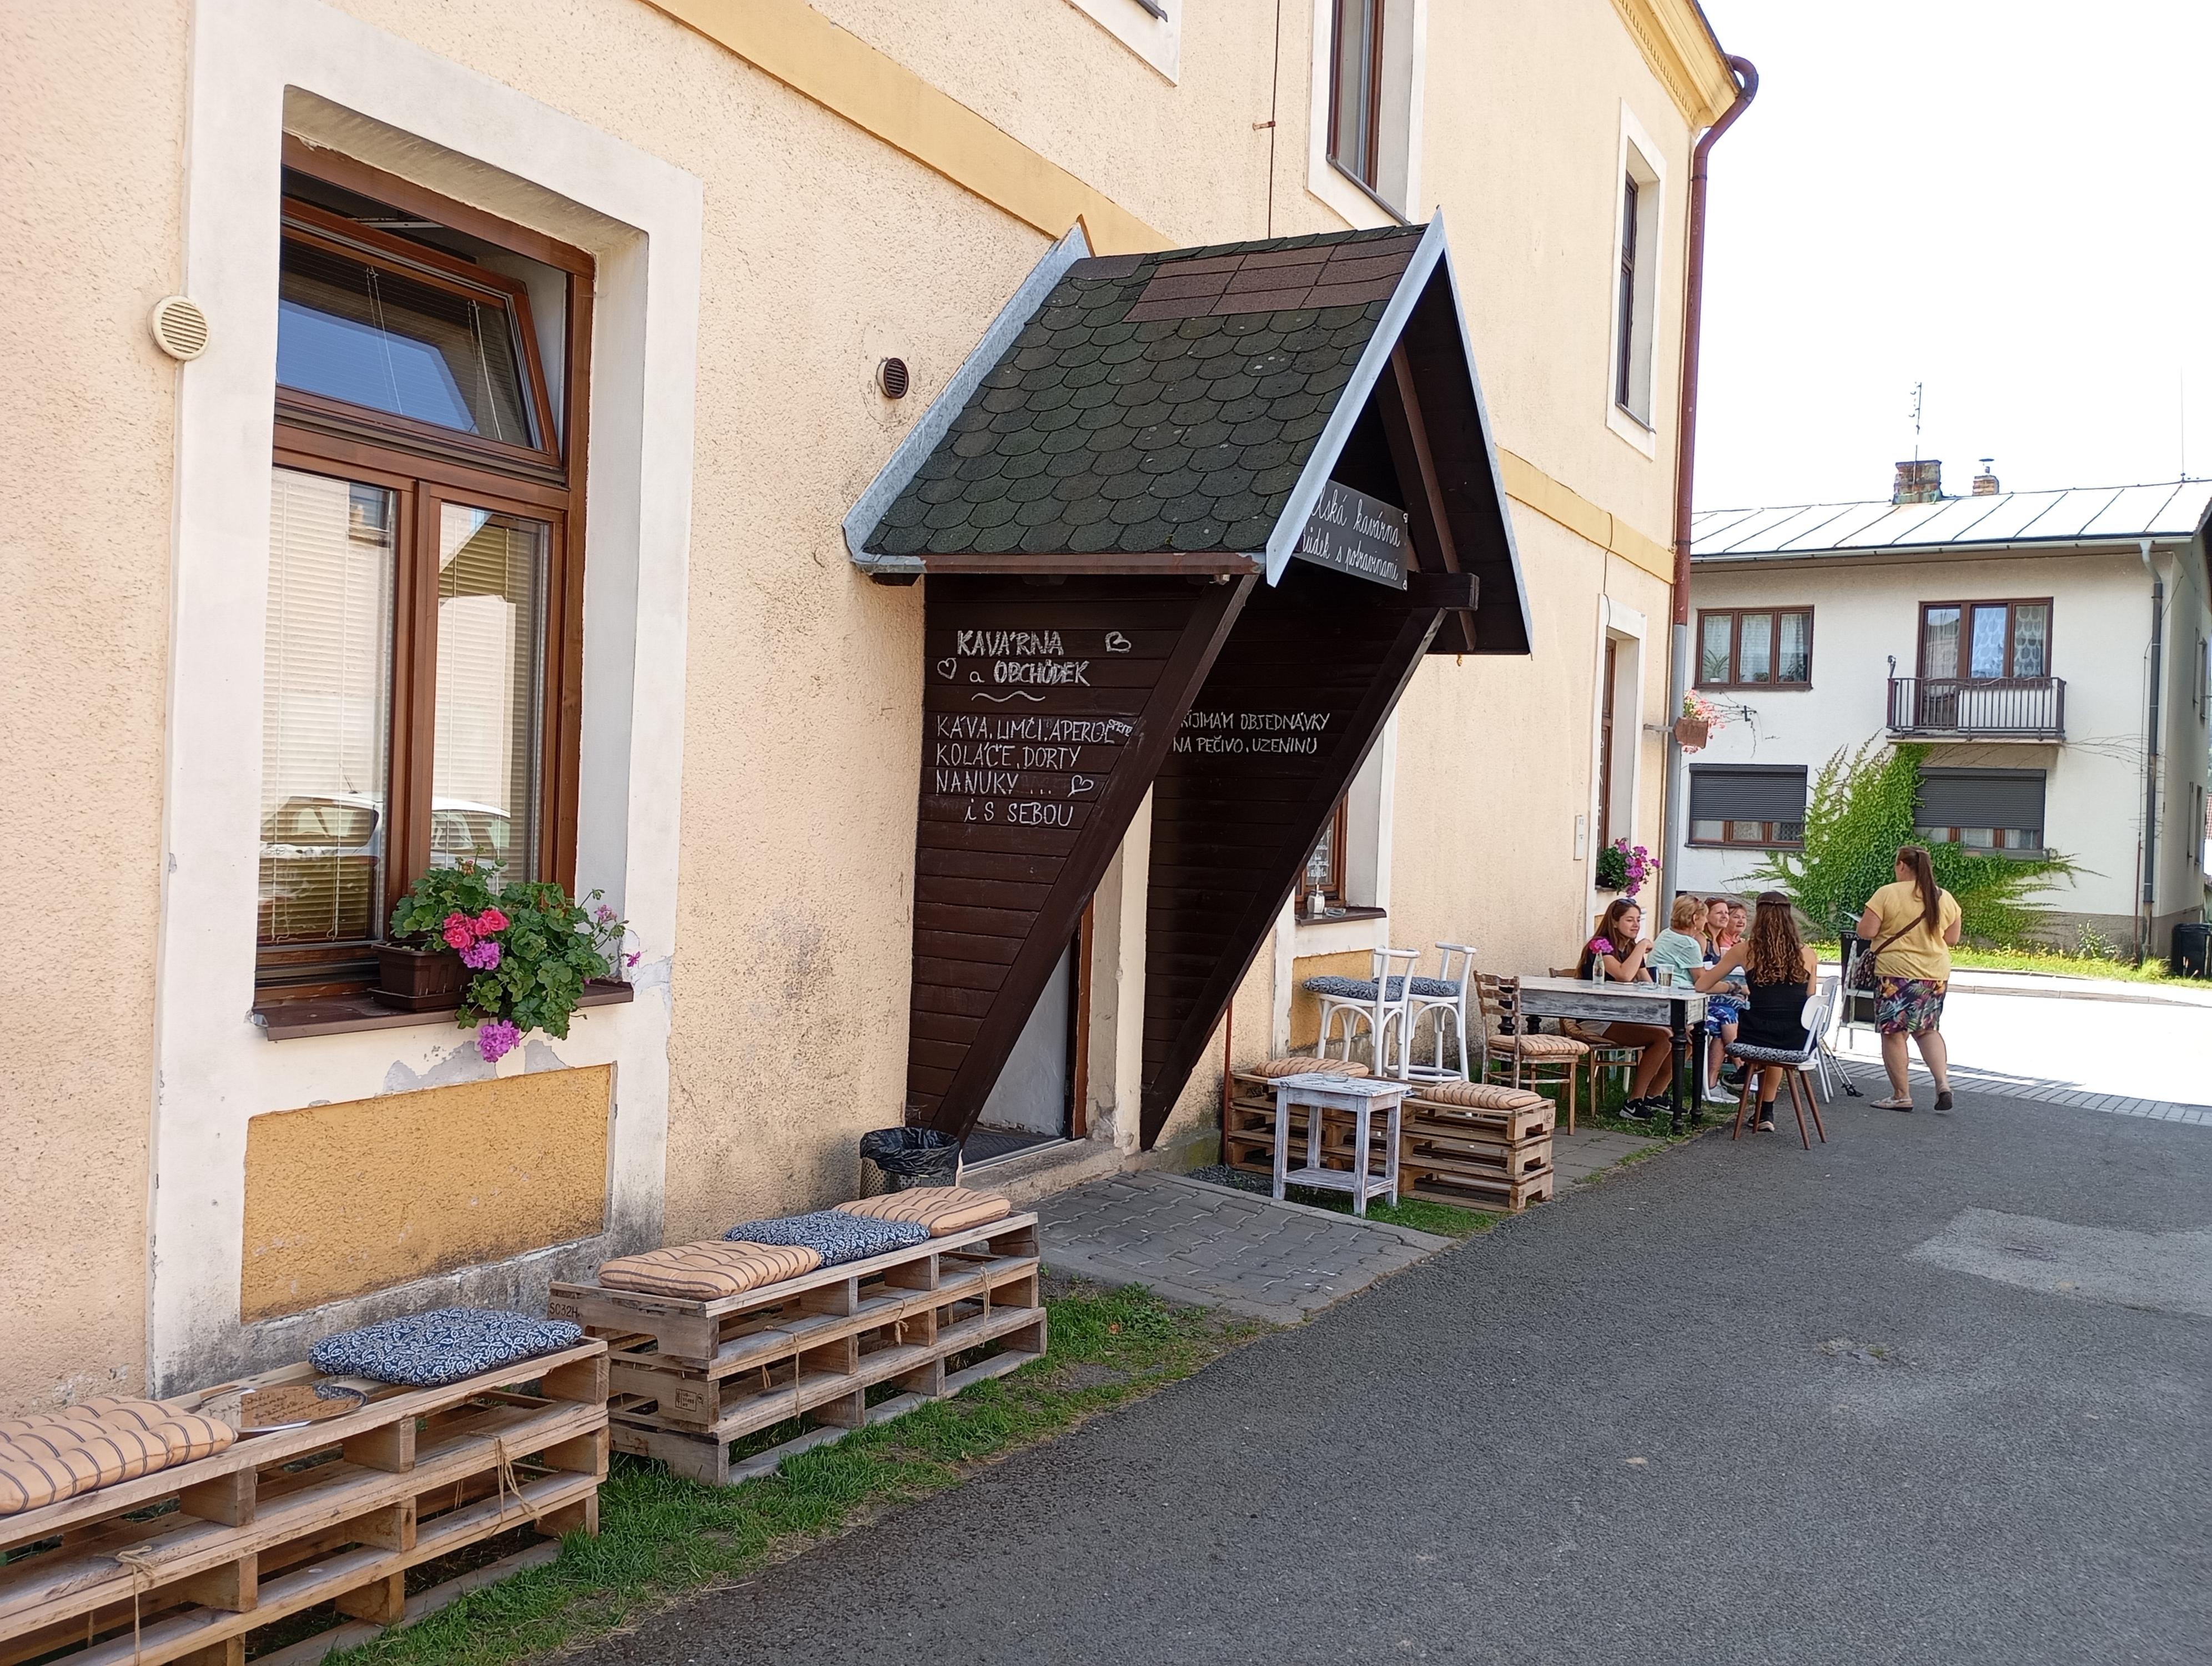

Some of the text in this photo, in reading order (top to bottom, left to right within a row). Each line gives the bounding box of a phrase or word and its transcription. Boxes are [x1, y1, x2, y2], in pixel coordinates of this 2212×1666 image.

[1353, 499, 1400, 548] kavárna
[1335, 545, 1342, 563] s
[1344, 540, 1399, 581] potravinami
[957, 630, 1064, 656] KAVÁRNA
[969, 659, 1091, 686] a OBCHŮDEK
[1048, 719, 1115, 744] APEROL
[1022, 745, 1082, 770] DORTY
[1173, 736, 1192, 753] NA
[1252, 736, 1318, 754] UZENINU
[1007, 802, 1073, 827] SEBOU
